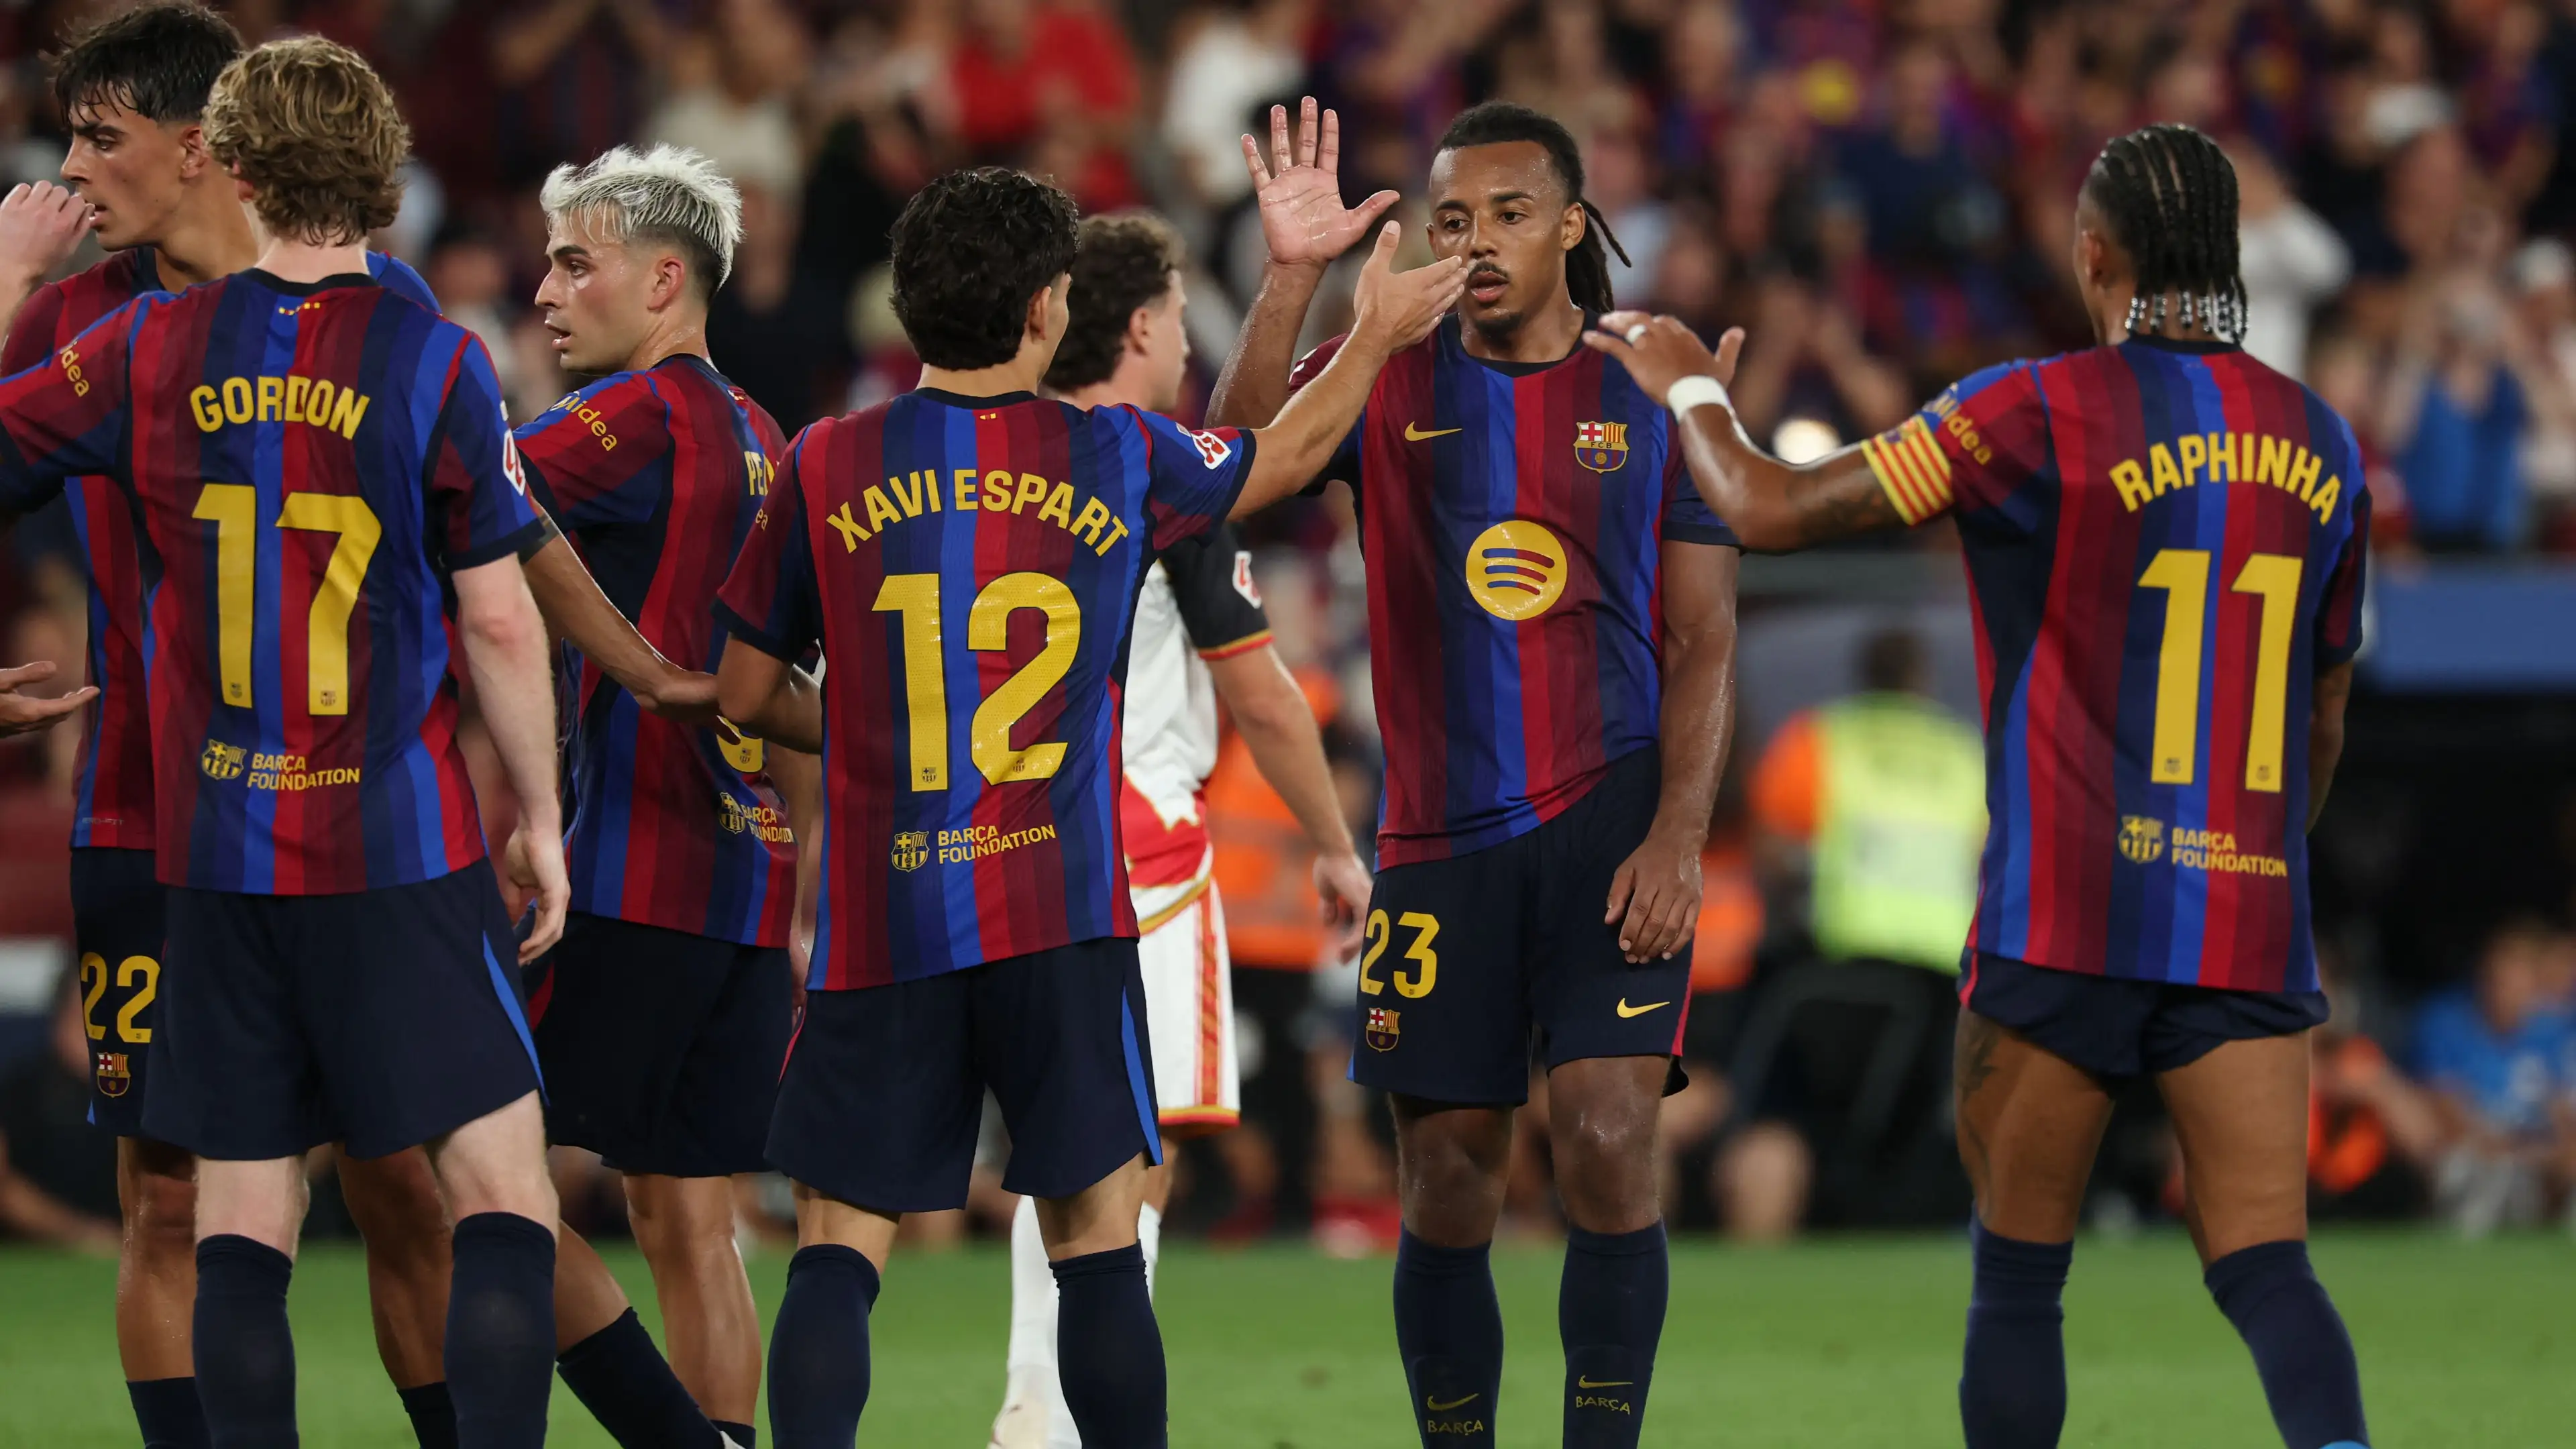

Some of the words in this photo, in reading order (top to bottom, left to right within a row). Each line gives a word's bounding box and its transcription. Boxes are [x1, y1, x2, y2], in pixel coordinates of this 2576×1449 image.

[60, 337, 89, 397] idea
[190, 374, 371, 441] GORDON
[2109, 431, 2342, 526] RAPHINHA
[826, 469, 942, 553] XAVI
[953, 469, 1129, 557] ESPART
[191, 483, 382, 716] 17
[871, 571, 1081, 792] 12
[2137, 547, 2304, 794] 11
[247, 767, 360, 791] FOUNDATION
[251, 753, 307, 774] BARÇA
[938, 825, 999, 845] BARÇA
[938, 824, 1057, 864] FOUNDATION
[2171, 847, 2288, 876] FOUNDATION
[2172, 826, 2237, 852] BARÇA
[1359, 908, 1440, 1000] 23
[80, 951, 161, 1044] 22
[1427, 1419, 1484, 1436] BARÇA
[1576, 1396, 1630, 1415] BARÇA
